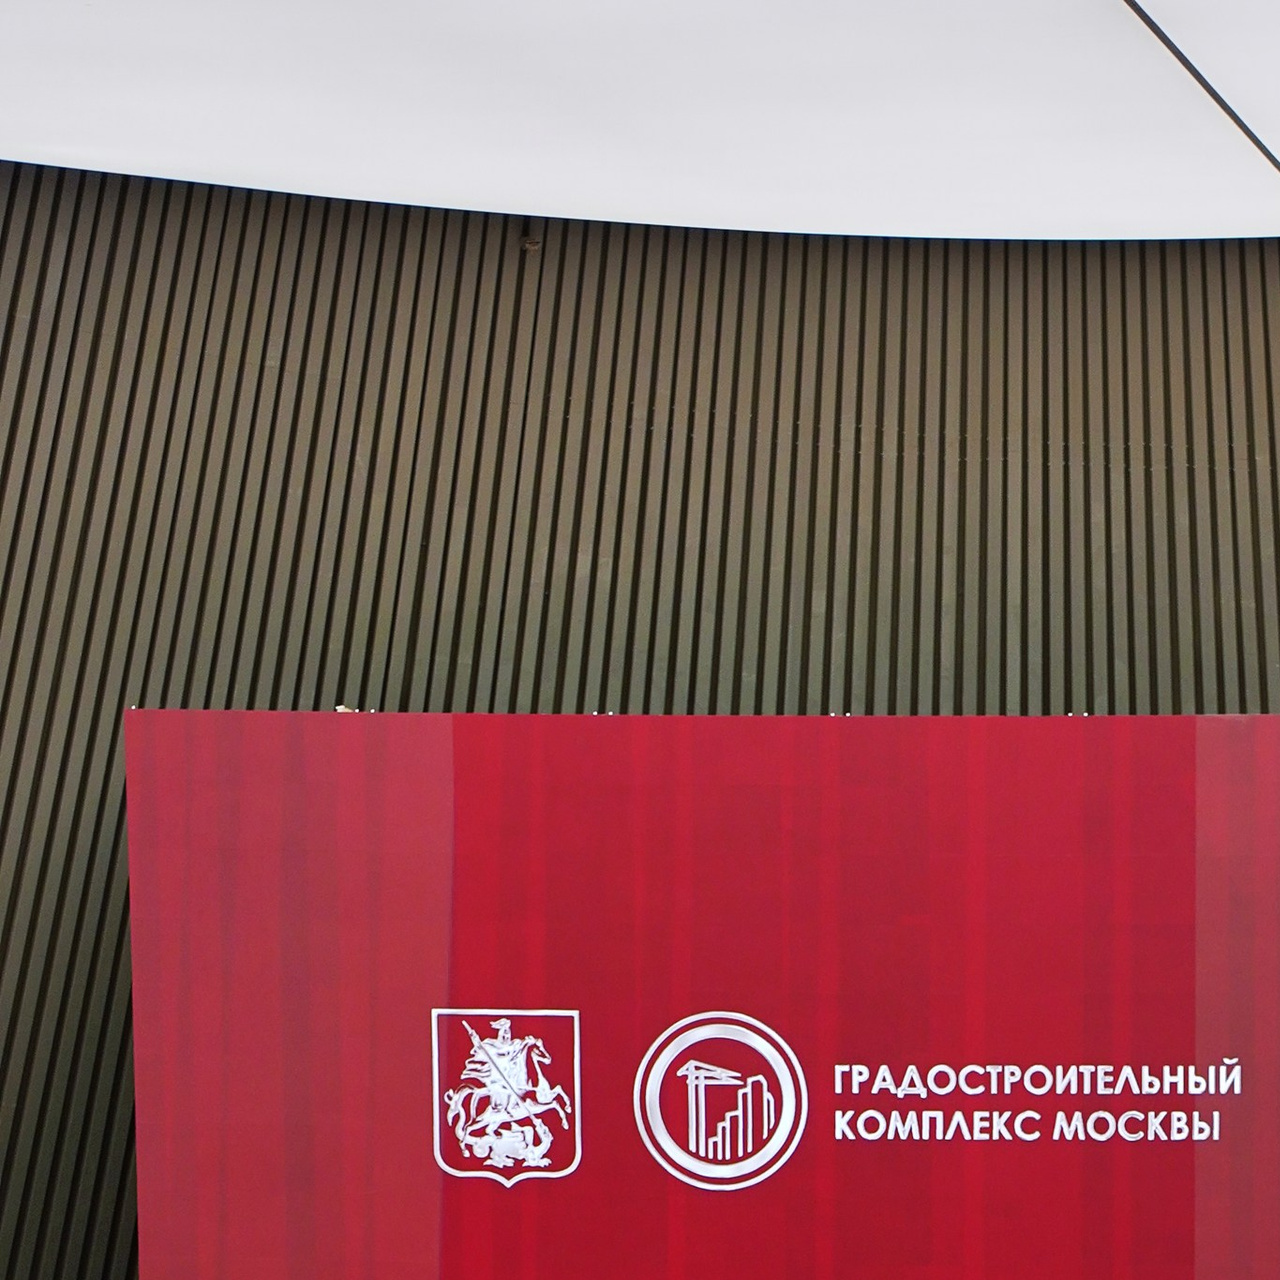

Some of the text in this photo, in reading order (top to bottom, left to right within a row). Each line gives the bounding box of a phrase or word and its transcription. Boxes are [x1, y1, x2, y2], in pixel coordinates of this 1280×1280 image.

[833, 1057, 1242, 1099] ГРАДОСТРОИТЕЛЬНЫЙ
[833, 1109, 1220, 1142] КОМПЛЕКС МОСКВЫ
